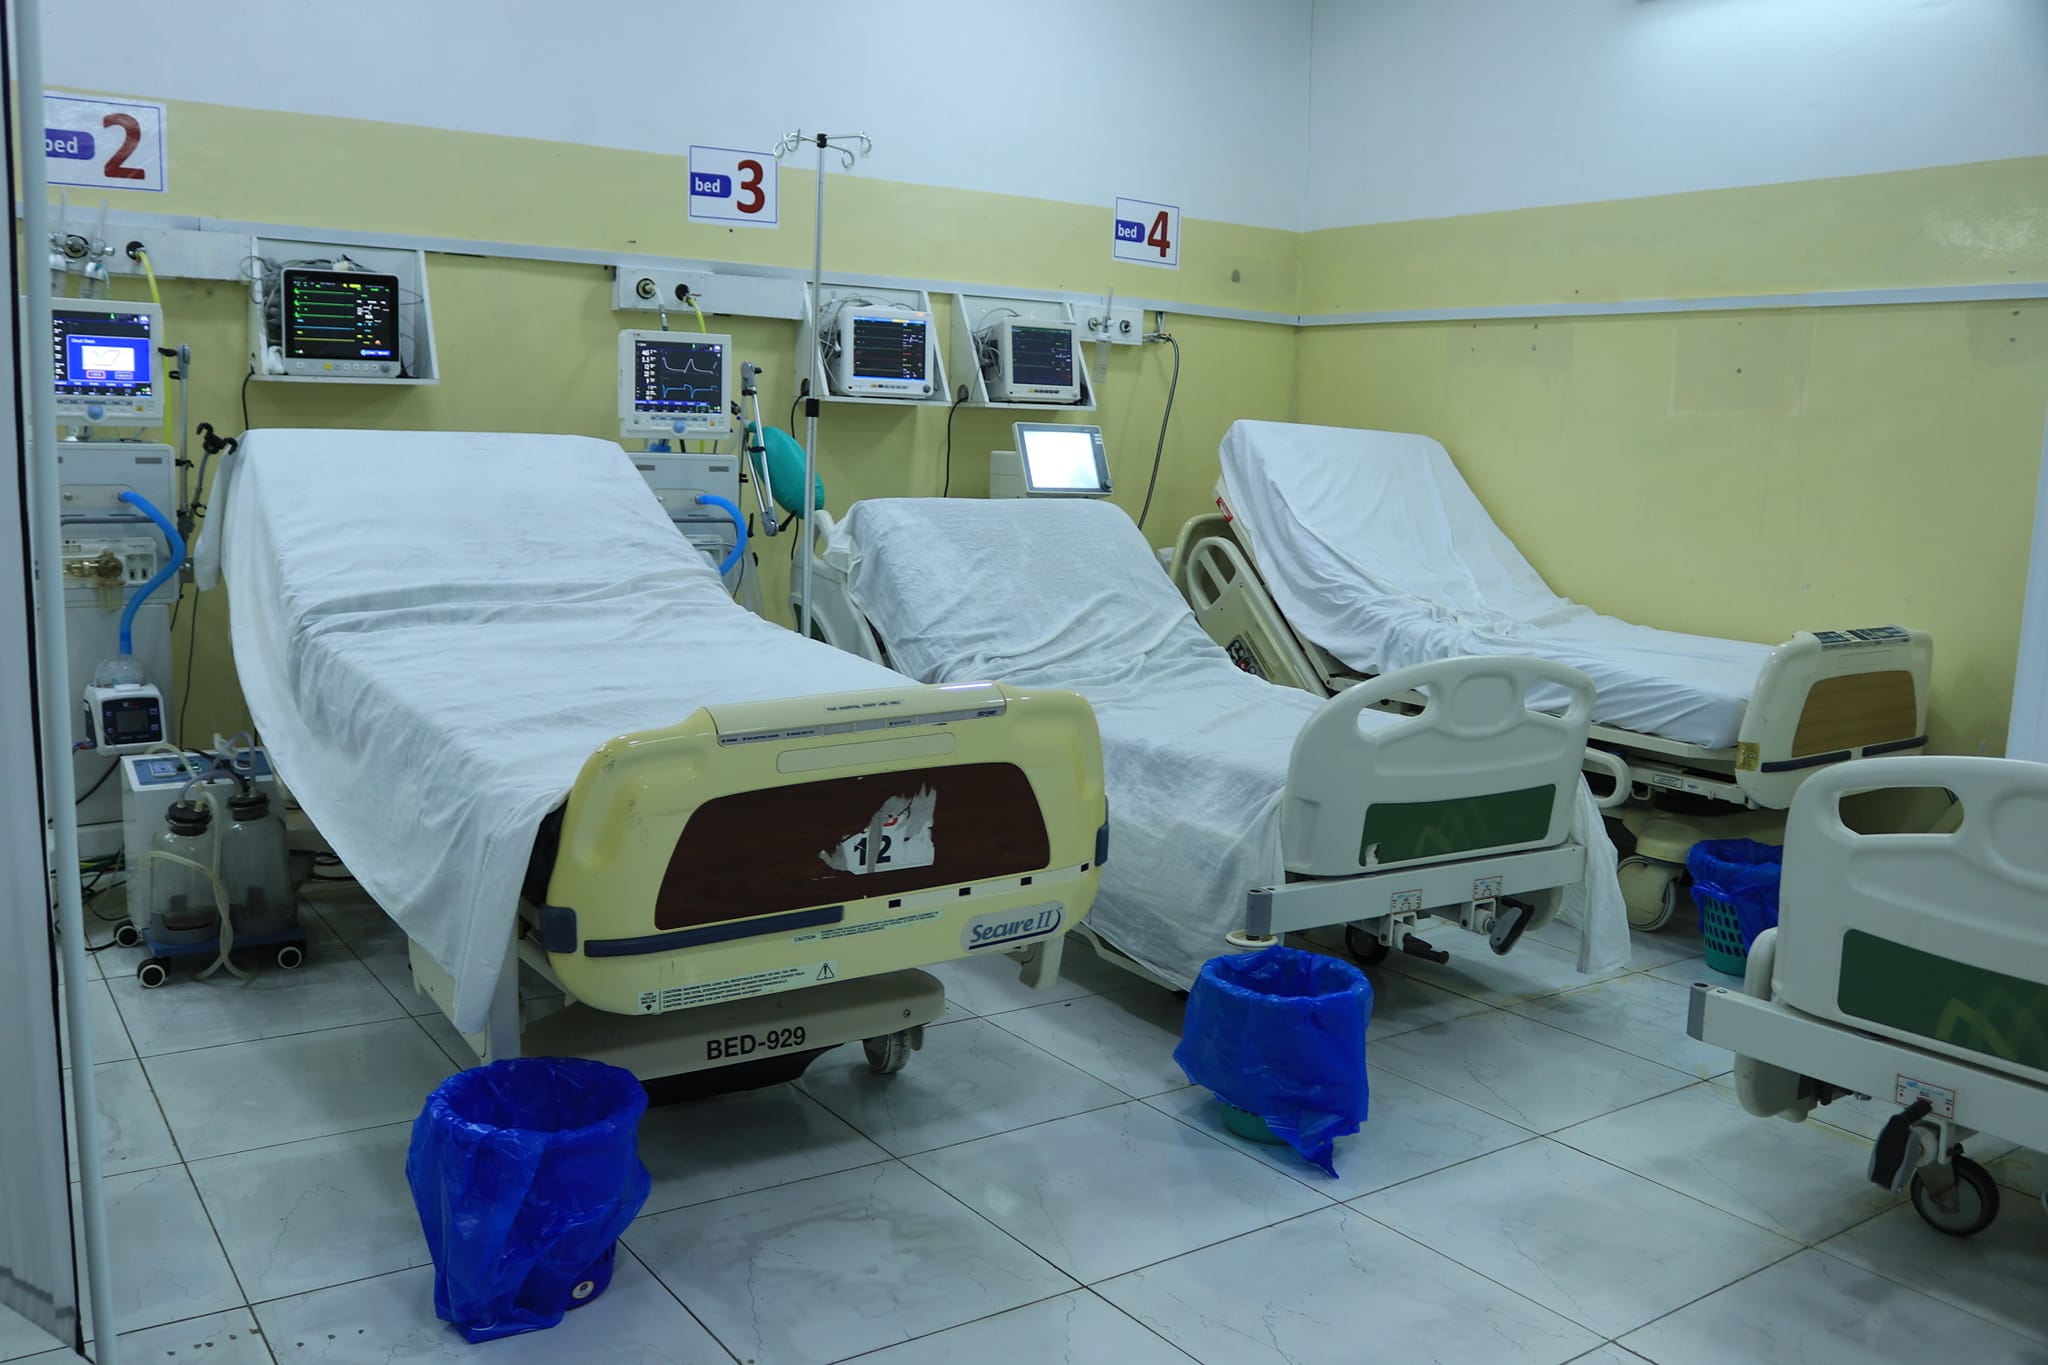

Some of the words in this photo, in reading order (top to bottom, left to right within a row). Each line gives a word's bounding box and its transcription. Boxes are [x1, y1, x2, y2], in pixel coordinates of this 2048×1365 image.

[102, 112, 145, 180] 2
[695, 176, 721, 193] bed
[736, 159, 765, 214] 3
[1118, 223, 1138, 239] bed
[1147, 210, 1171, 258] 4
[970, 918, 1034, 943] Secure
[706, 1026, 806, 1060] BED-929
